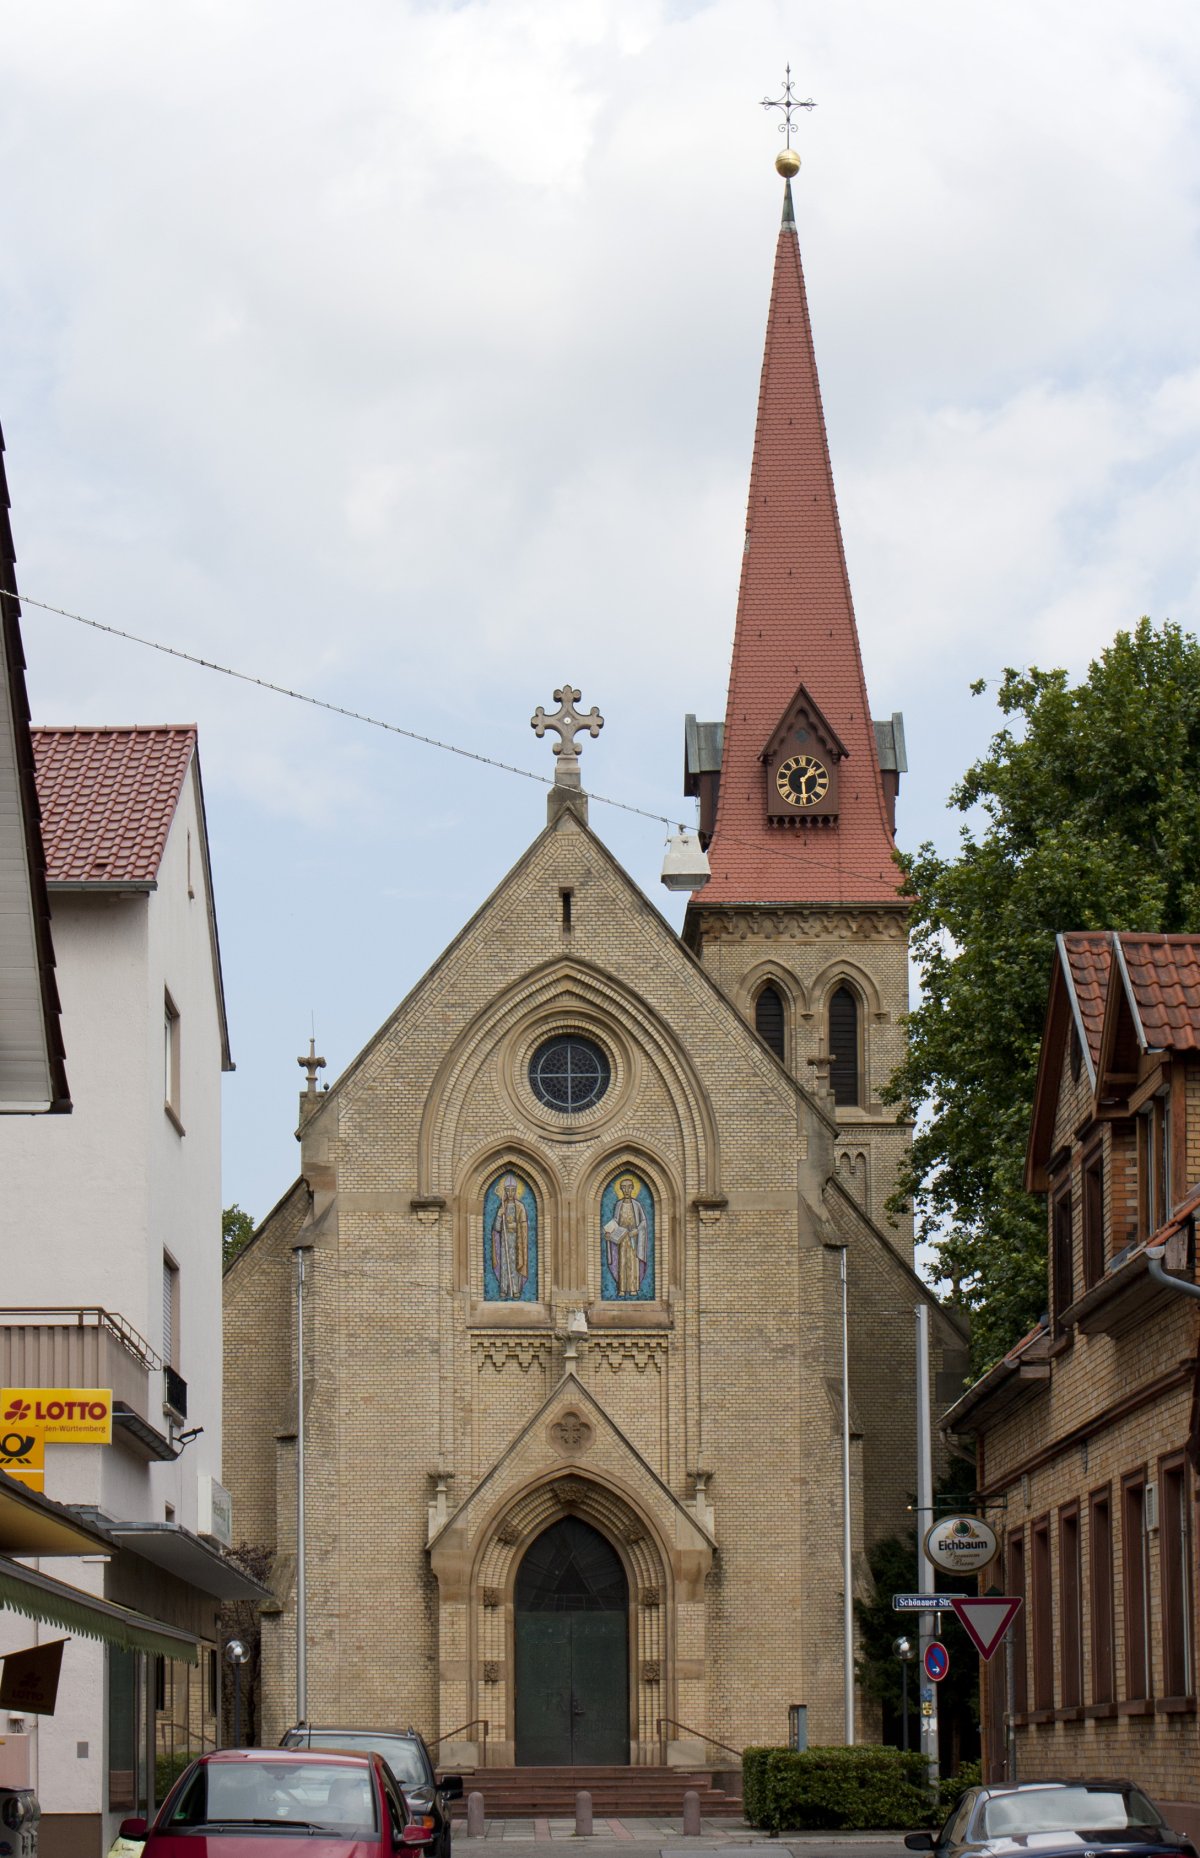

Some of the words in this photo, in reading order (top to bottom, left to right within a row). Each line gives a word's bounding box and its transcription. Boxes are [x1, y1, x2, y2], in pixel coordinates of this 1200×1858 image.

[35, 1401, 107, 1420] LOTTO
[35, 1424, 106, 1433] den-Württemberg
[938, 1540, 988, 1551] Eichbaum
[899, 1598, 938, 1607] Schönauer
